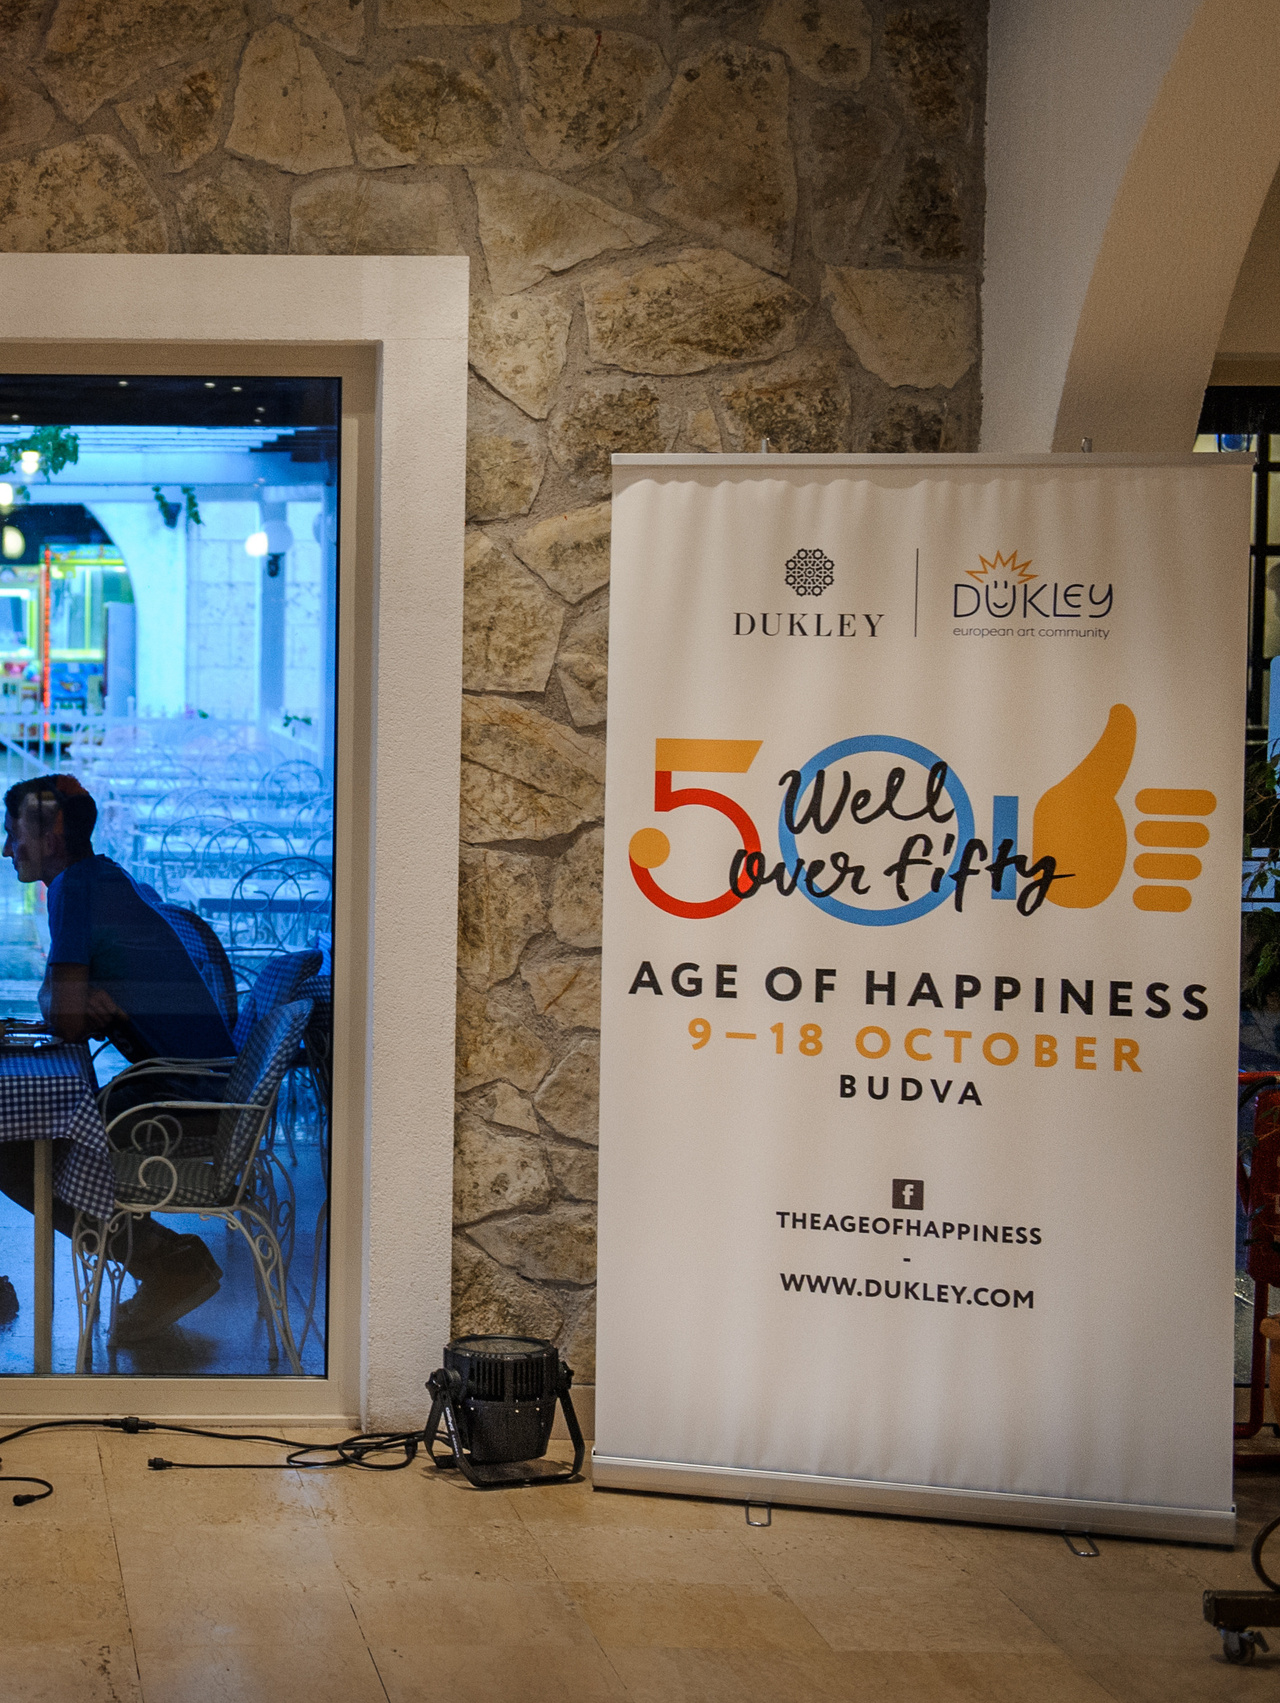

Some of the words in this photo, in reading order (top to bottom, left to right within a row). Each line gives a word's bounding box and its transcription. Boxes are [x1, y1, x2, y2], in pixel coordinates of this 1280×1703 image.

[733, 612, 884, 638] DUKLEY
[953, 628, 1016, 640] european
[1017, 628, 1036, 637] art
[1038, 628, 1111, 641] community
[779, 761, 955, 834] Well
[730, 850, 870, 898] over
[884, 834, 1074, 916] fifty
[629, 961, 737, 998] AGE
[766, 967, 836, 1002] OF
[866, 971, 1208, 1020] HAPPINESS
[856, 1026, 1141, 1072] OCTOBER
[840, 1075, 982, 1105] BUDVA
[776, 1211, 1042, 1246] THEAGEOFHAPPINESS
[781, 1274, 1033, 1308] WWW.DUKLEY.COM
